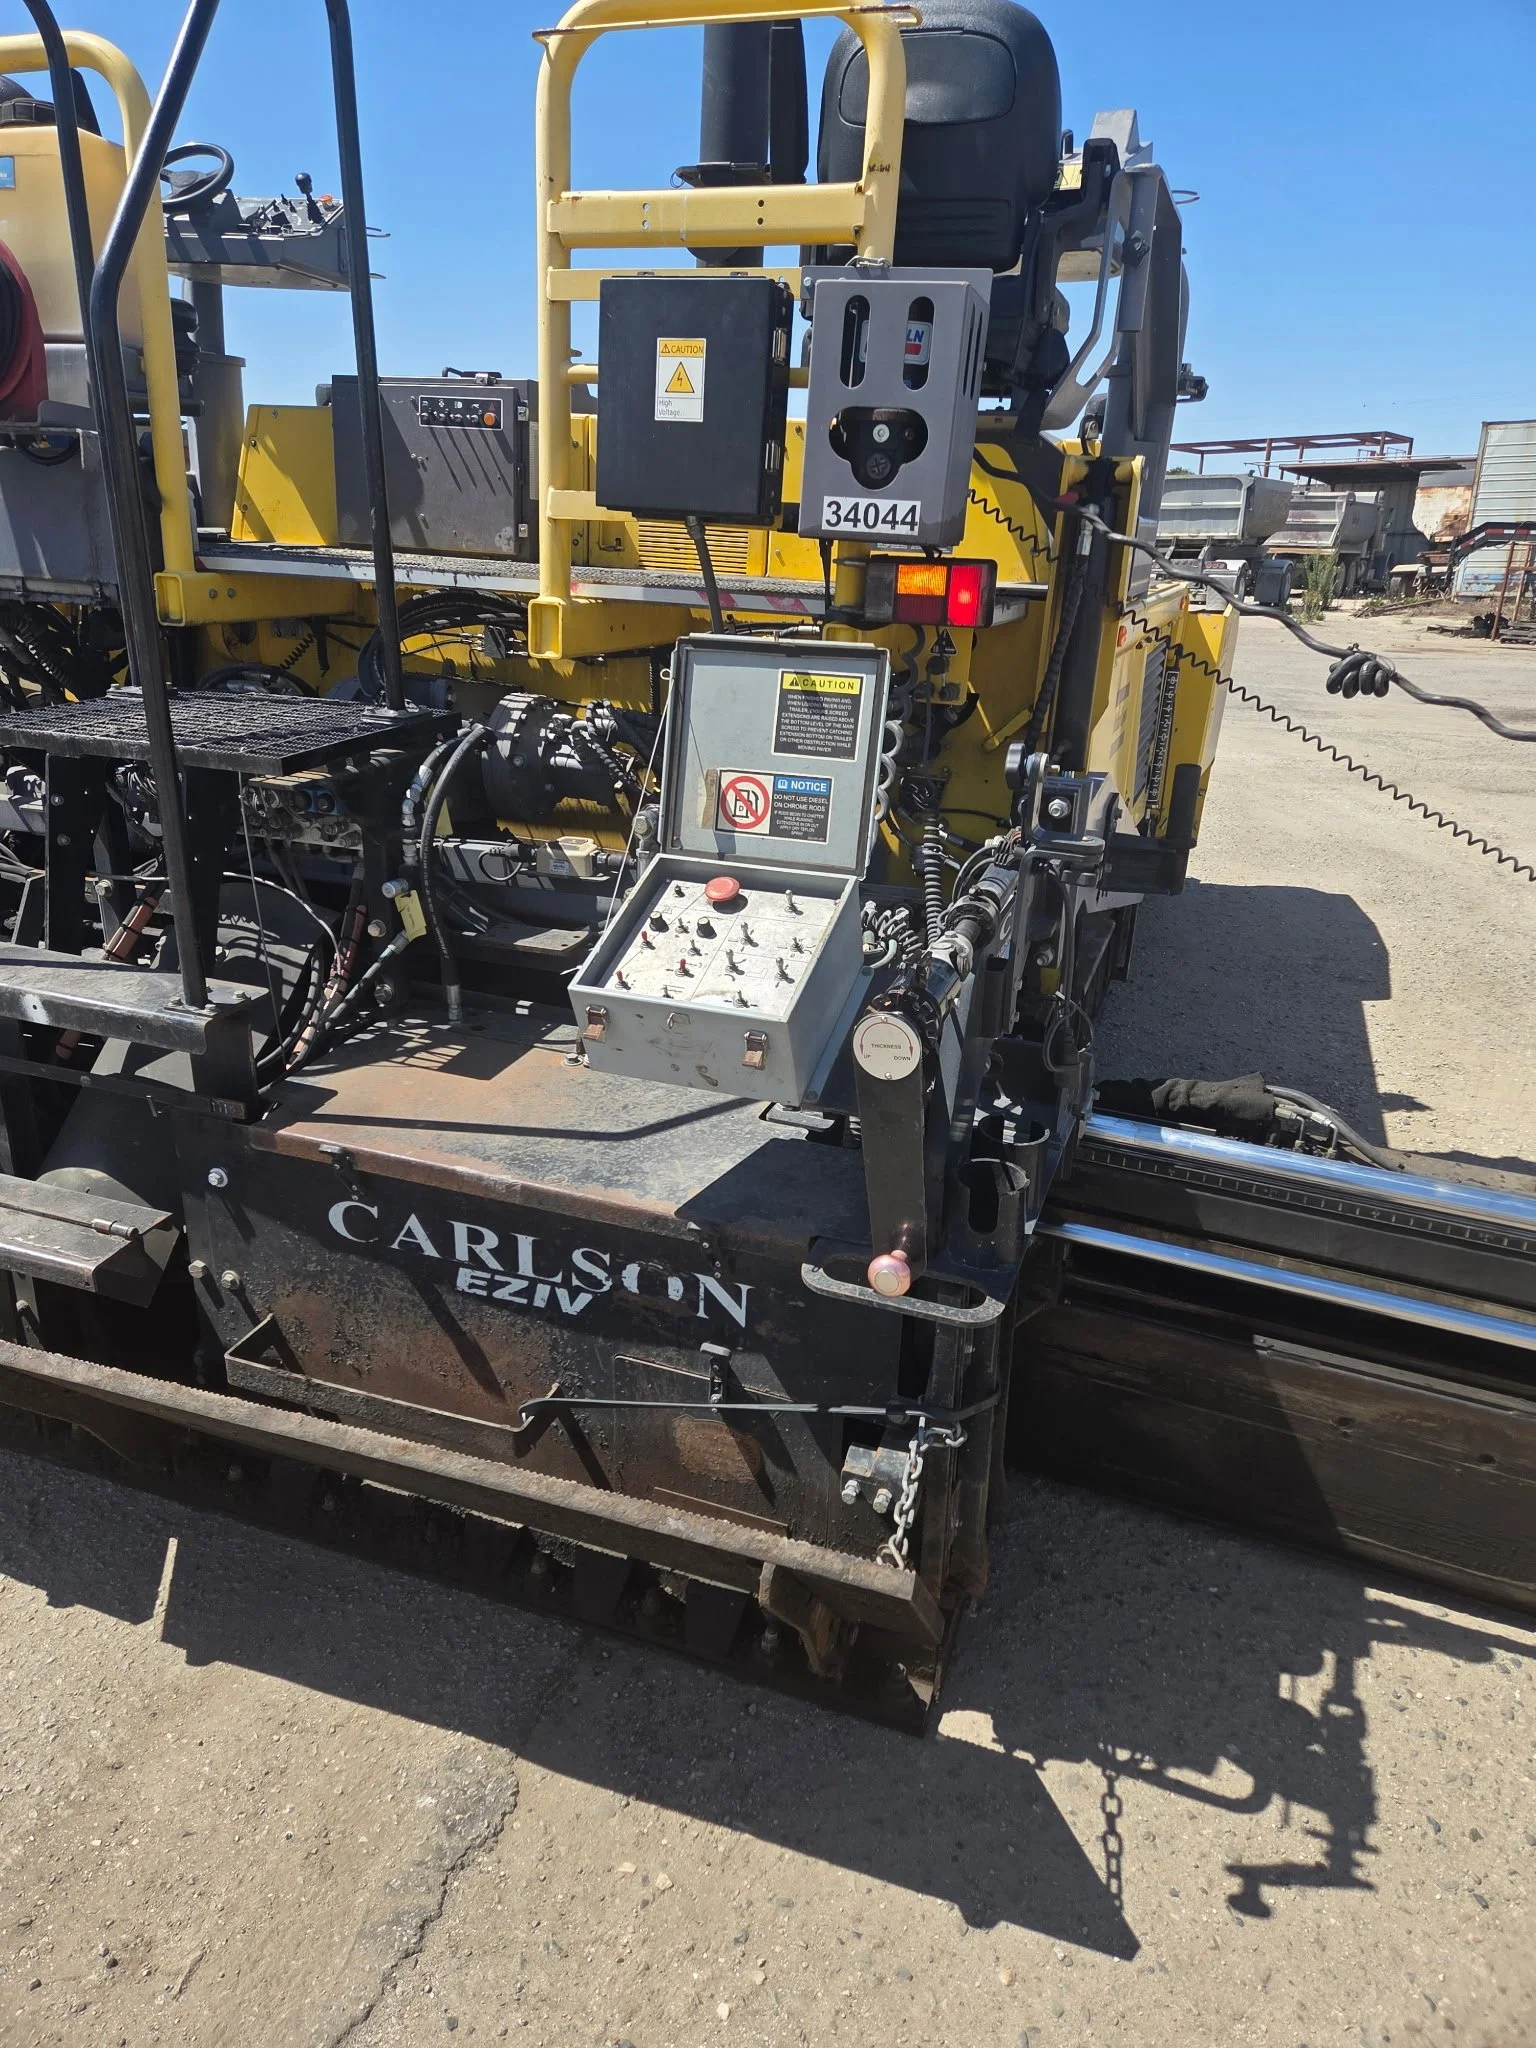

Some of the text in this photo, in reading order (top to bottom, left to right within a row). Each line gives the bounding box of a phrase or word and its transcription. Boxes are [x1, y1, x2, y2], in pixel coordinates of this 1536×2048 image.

[906, 329, 924, 342] LN
[671, 345, 704, 354] CAUTION
[658, 399, 673, 407] High
[658, 408, 681, 417] Voltage
[825, 500, 918, 531] 34044
[802, 678, 855, 690] CAUTION
[791, 780, 827, 792] NOTICE
[783, 802, 807, 811] CHROME
[808, 804, 825, 812] RODS
[328, 1200, 756, 1329] CARLSON
[456, 1268, 595, 1316] EZIV
